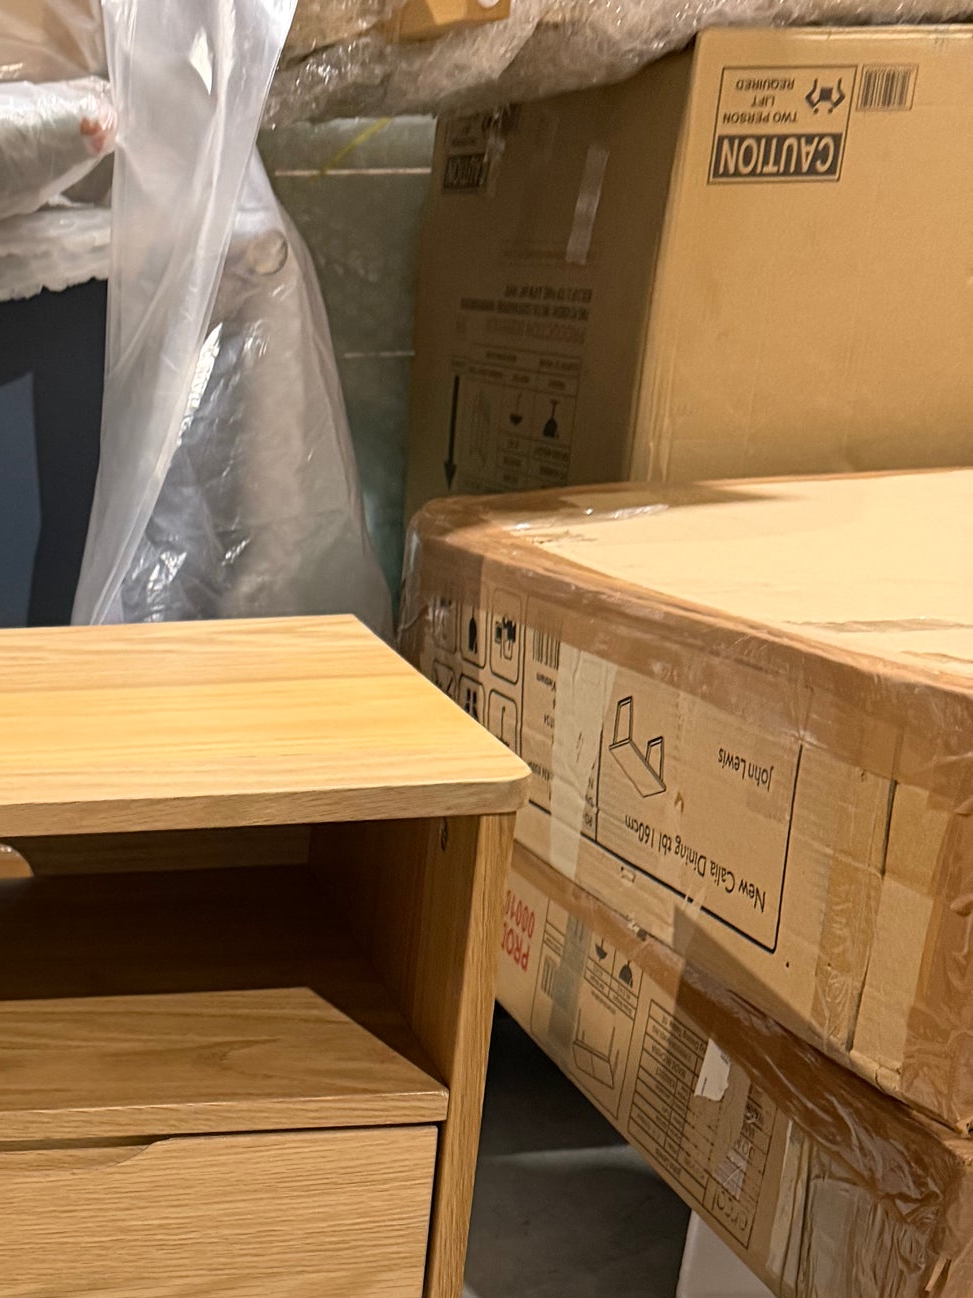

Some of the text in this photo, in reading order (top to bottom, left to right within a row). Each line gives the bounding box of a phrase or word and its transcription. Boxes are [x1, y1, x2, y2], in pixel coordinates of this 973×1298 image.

[735, 78, 795, 91] REQUIRED
[750, 95, 776, 108] LIFT
[722, 111, 798, 124] TWO PERSON
[718, 135, 835, 176] CAUTION
[717, 747, 775, 792] John Lewis
[624, 814, 656, 848] 160cm
[674, 835, 707, 878] Dining
[738, 878, 766, 913] New
